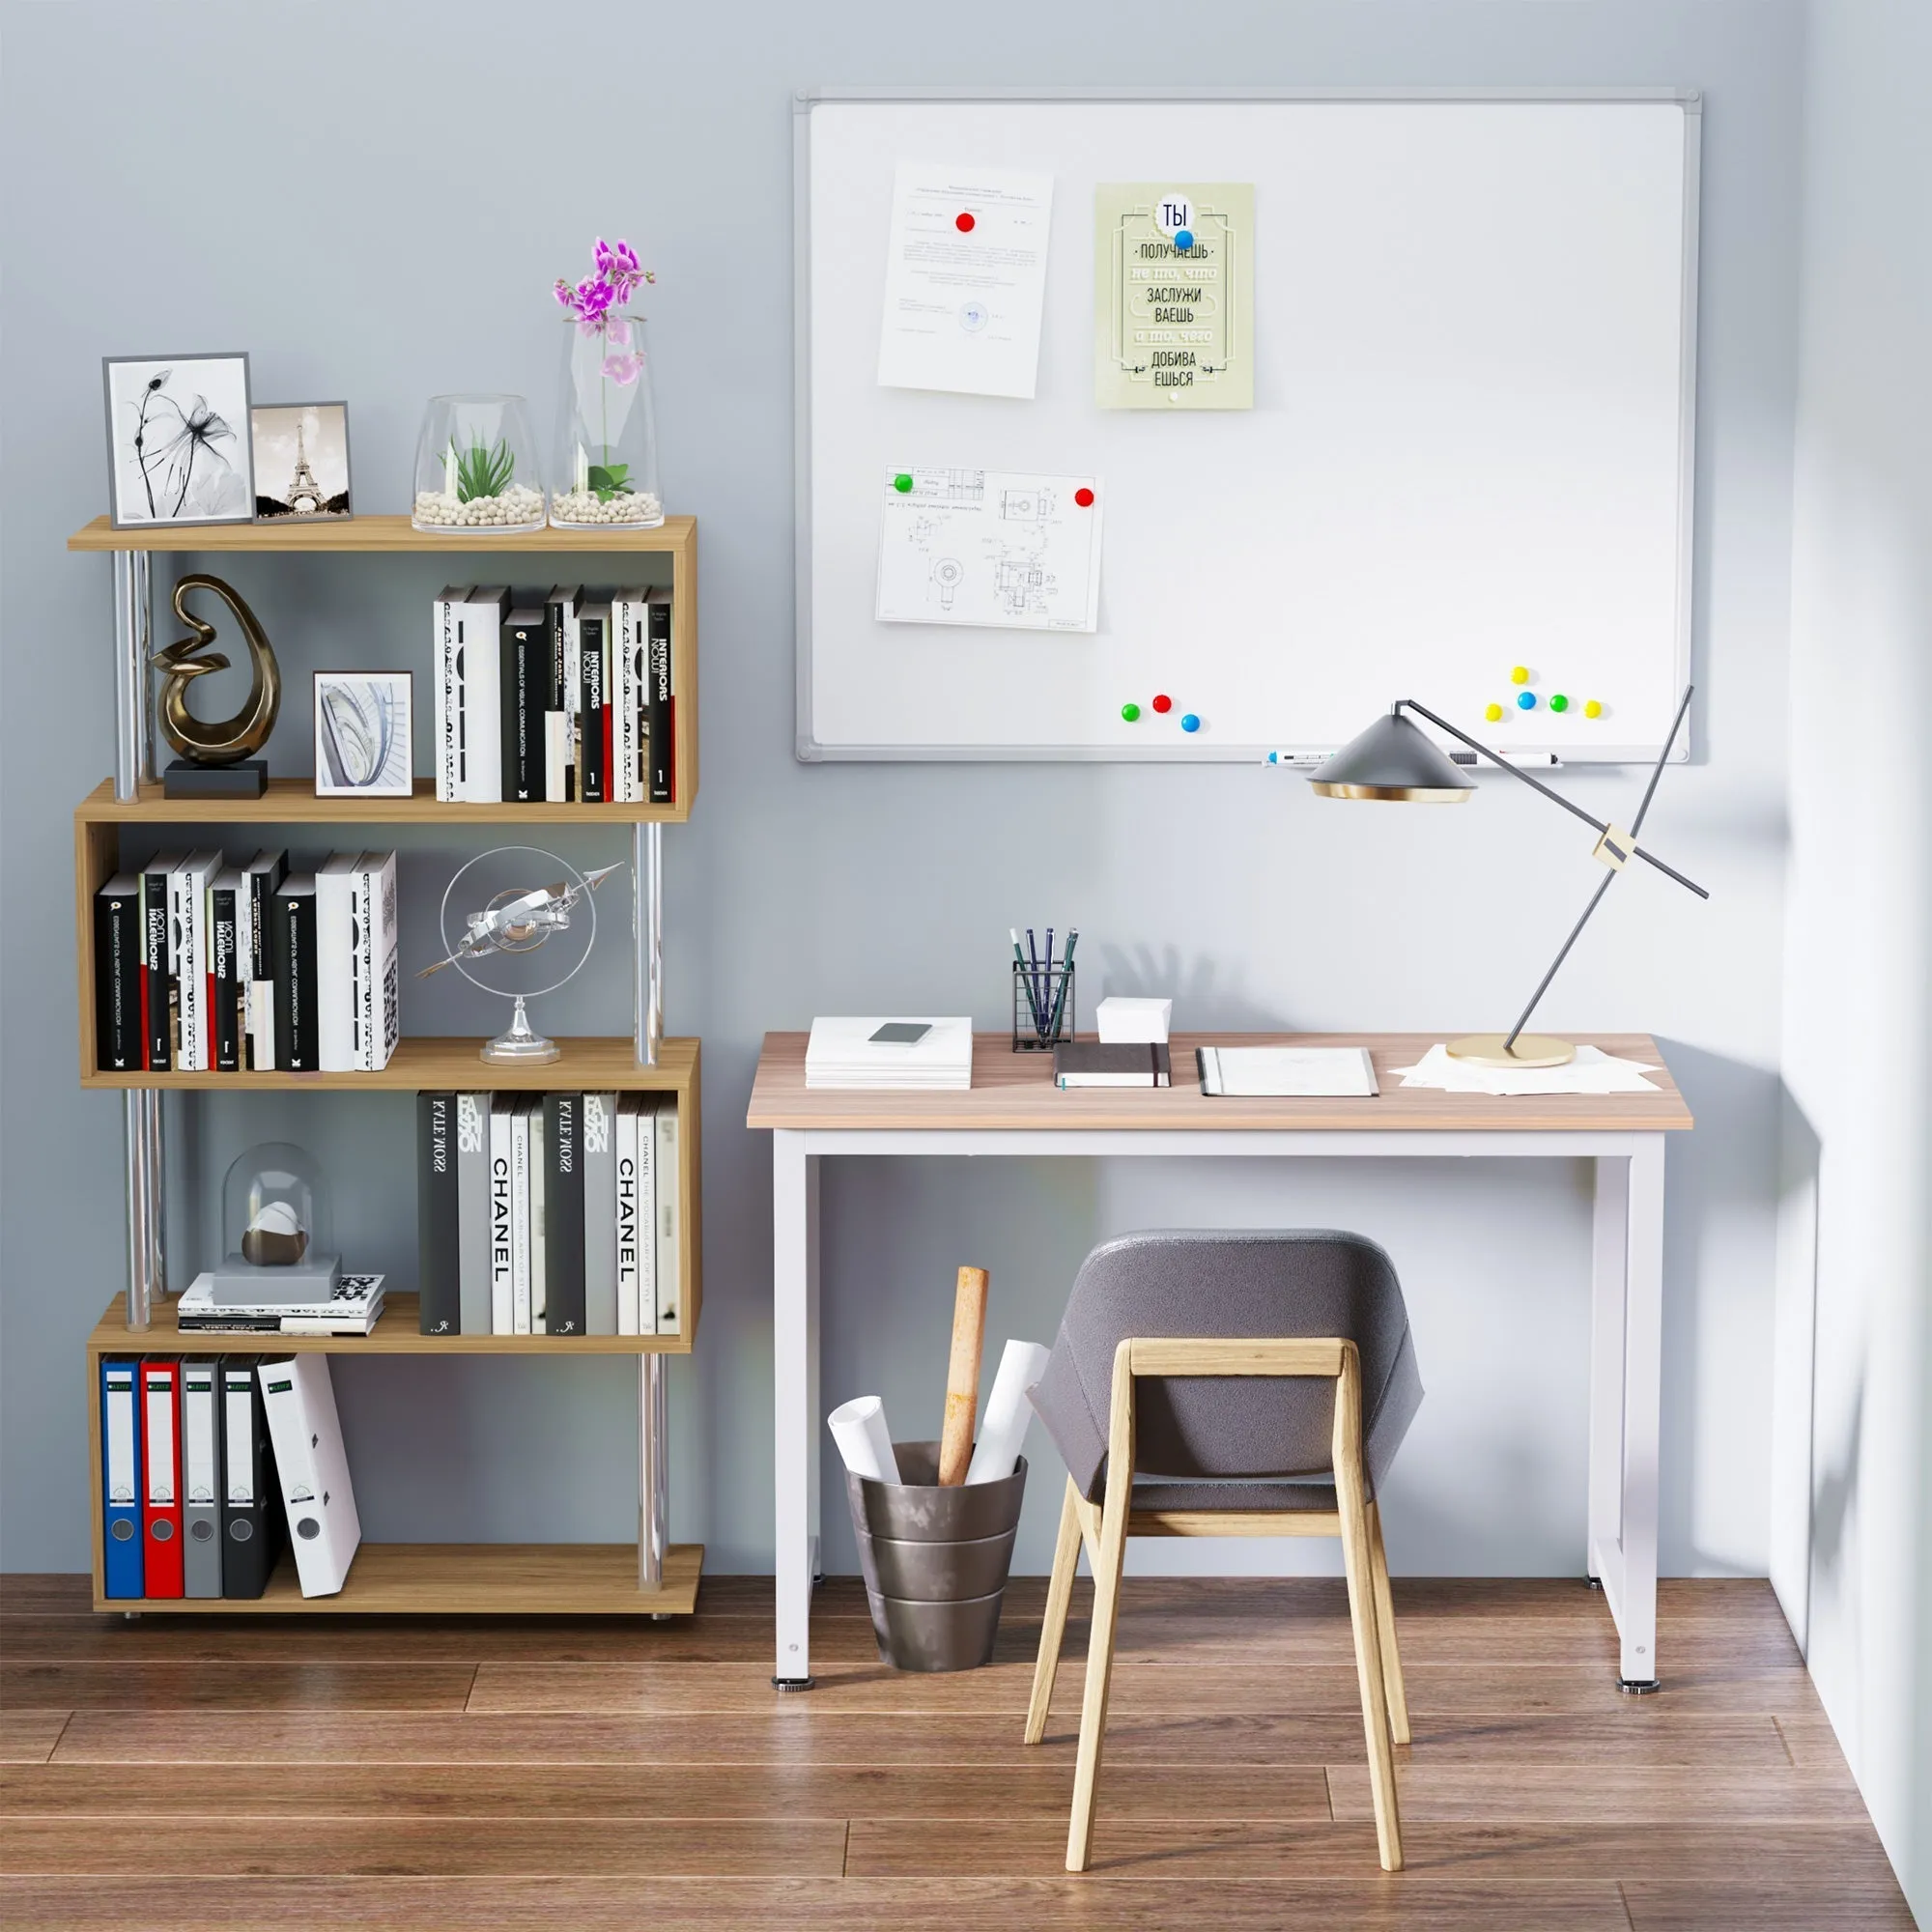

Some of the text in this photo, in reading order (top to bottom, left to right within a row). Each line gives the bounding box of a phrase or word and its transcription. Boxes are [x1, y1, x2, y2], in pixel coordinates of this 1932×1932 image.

[1163, 204, 1186, 226] ТЫ
[1141, 243, 1208, 259] ПОЛУЧАЕШЬ
[1130, 268, 1150, 280] не
[1184, 268, 1217, 280] что
[1147, 288, 1202, 302] ЗАСЛУЖИ
[1155, 307, 1194, 323] ВАЕШЬ
[1151, 352, 1196, 368] ДОБИВА
[1154, 372, 1194, 386] ЕШЬСЯ
[659, 639, 668, 701] INTERIORS
[591, 651, 600, 709] INTERIORS
[589, 772, 595, 785] 1
[658, 770, 663, 783] 1
[494, 1158, 509, 1282] CHANEL
[619, 1158, 635, 1282] CHANEL
